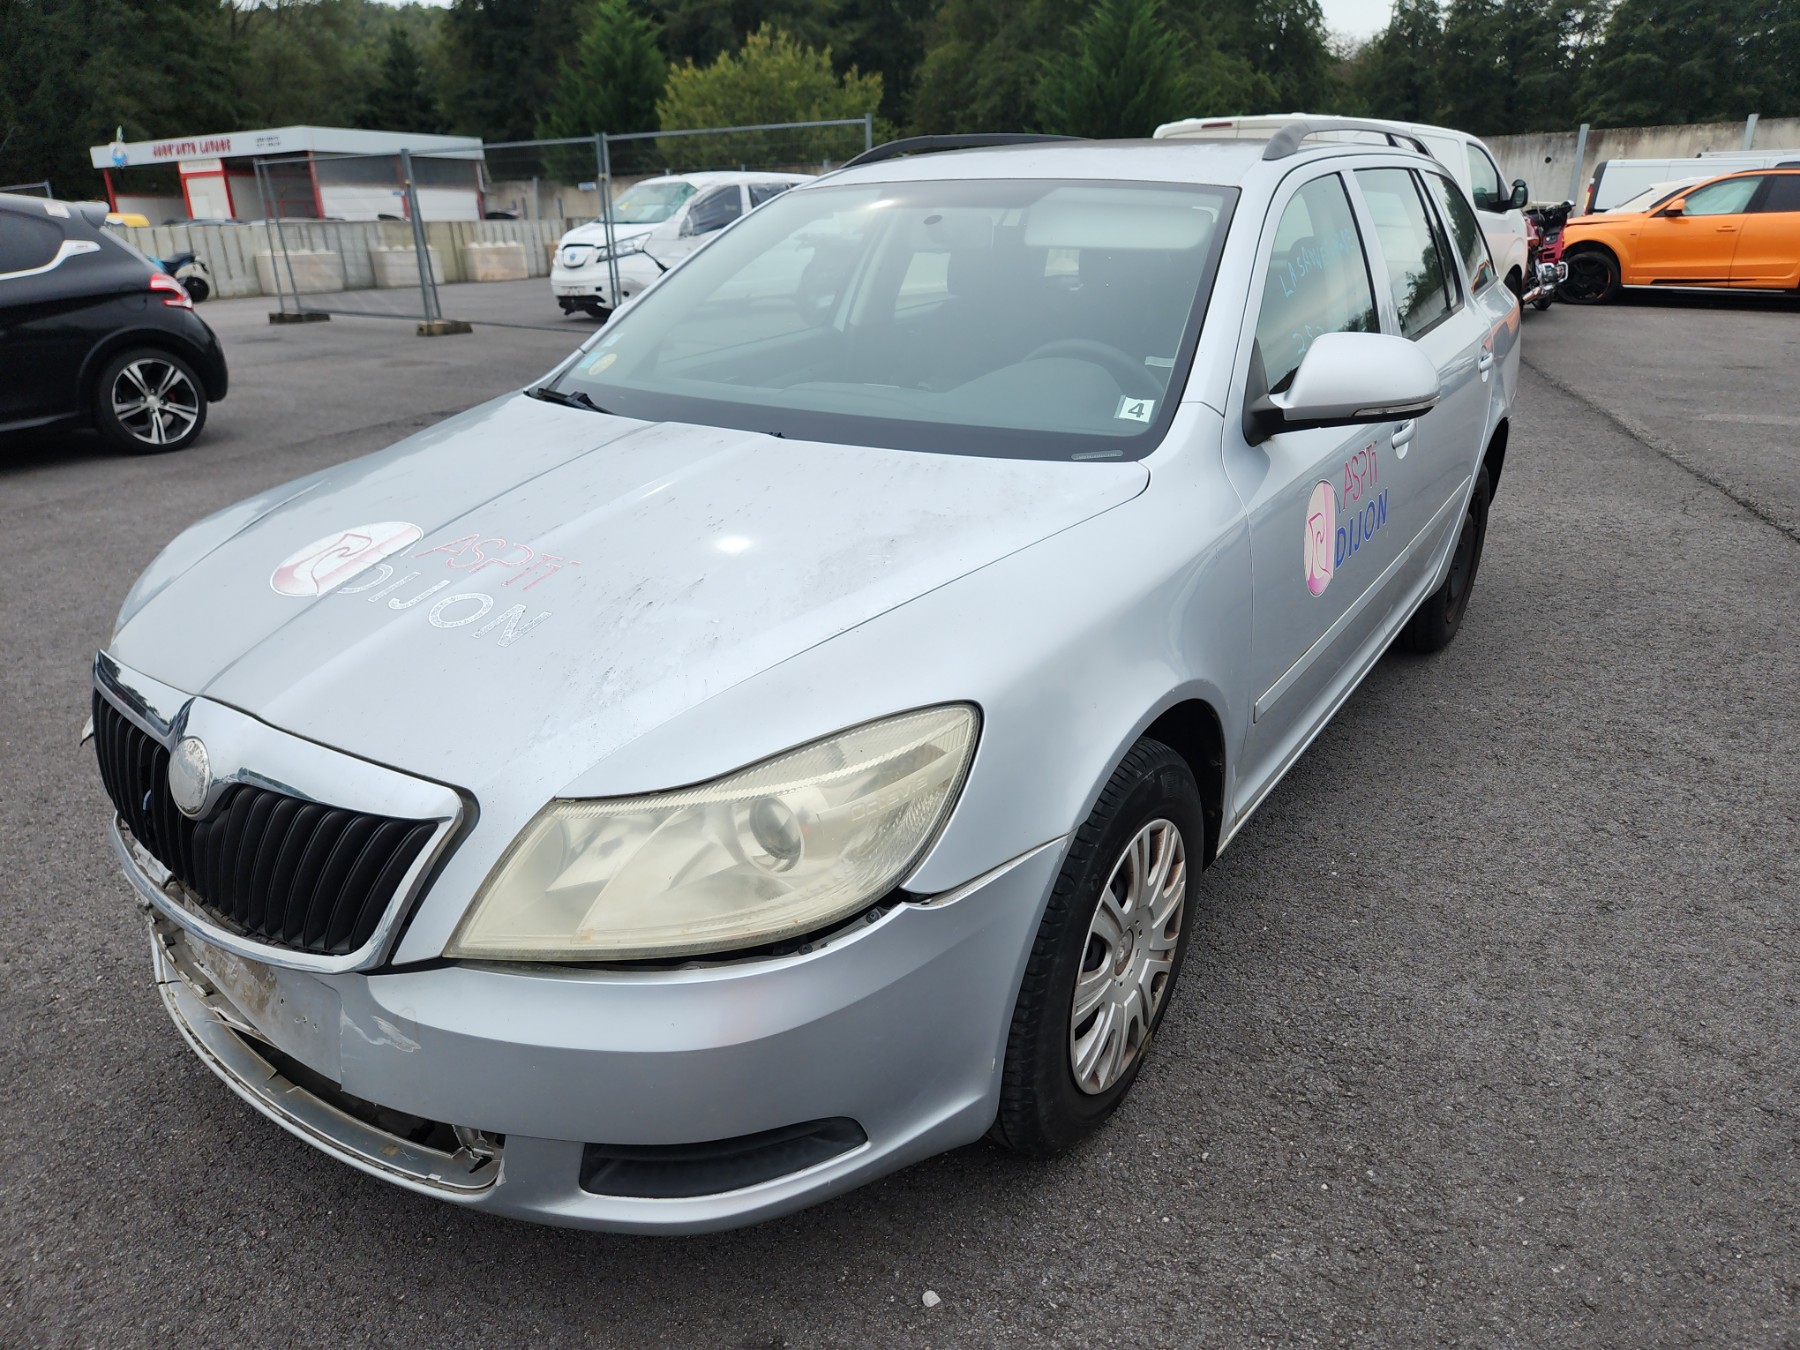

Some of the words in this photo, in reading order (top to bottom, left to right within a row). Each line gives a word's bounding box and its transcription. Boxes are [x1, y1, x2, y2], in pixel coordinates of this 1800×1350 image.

[1127, 402, 1145, 418] 4
[1335, 487, 1389, 569] DIJON
[336, 563, 553, 648] DIJON
